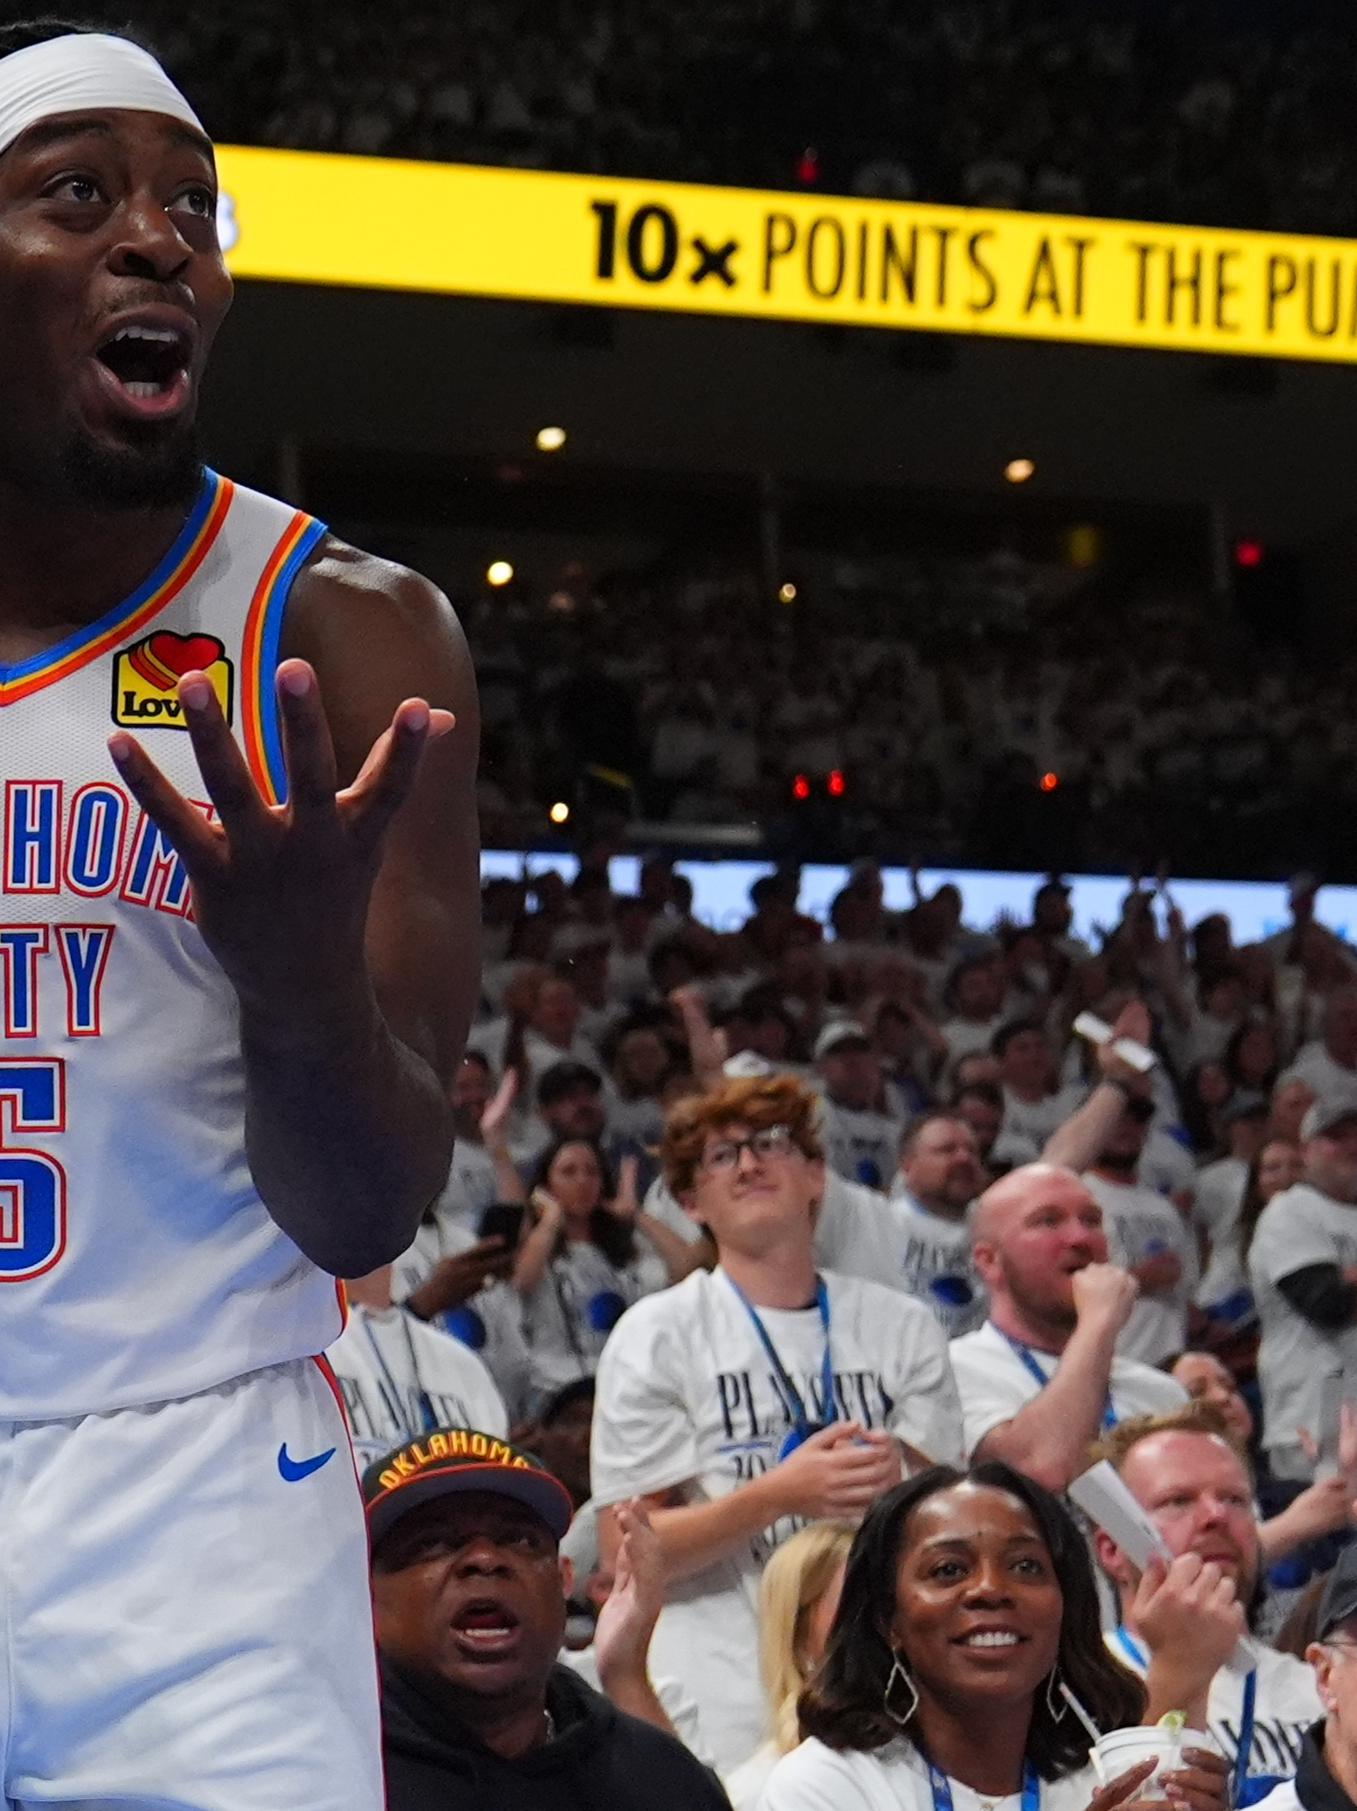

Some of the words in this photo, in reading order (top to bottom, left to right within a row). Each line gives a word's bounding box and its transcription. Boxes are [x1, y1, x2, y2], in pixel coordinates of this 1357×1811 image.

[762, 211, 998, 314] POINTS
[1024, 236, 1096, 320] AT
[1129, 240, 1244, 334] THE
[1265, 253, 1357, 340] PU
[121, 690, 183, 718] Lov
